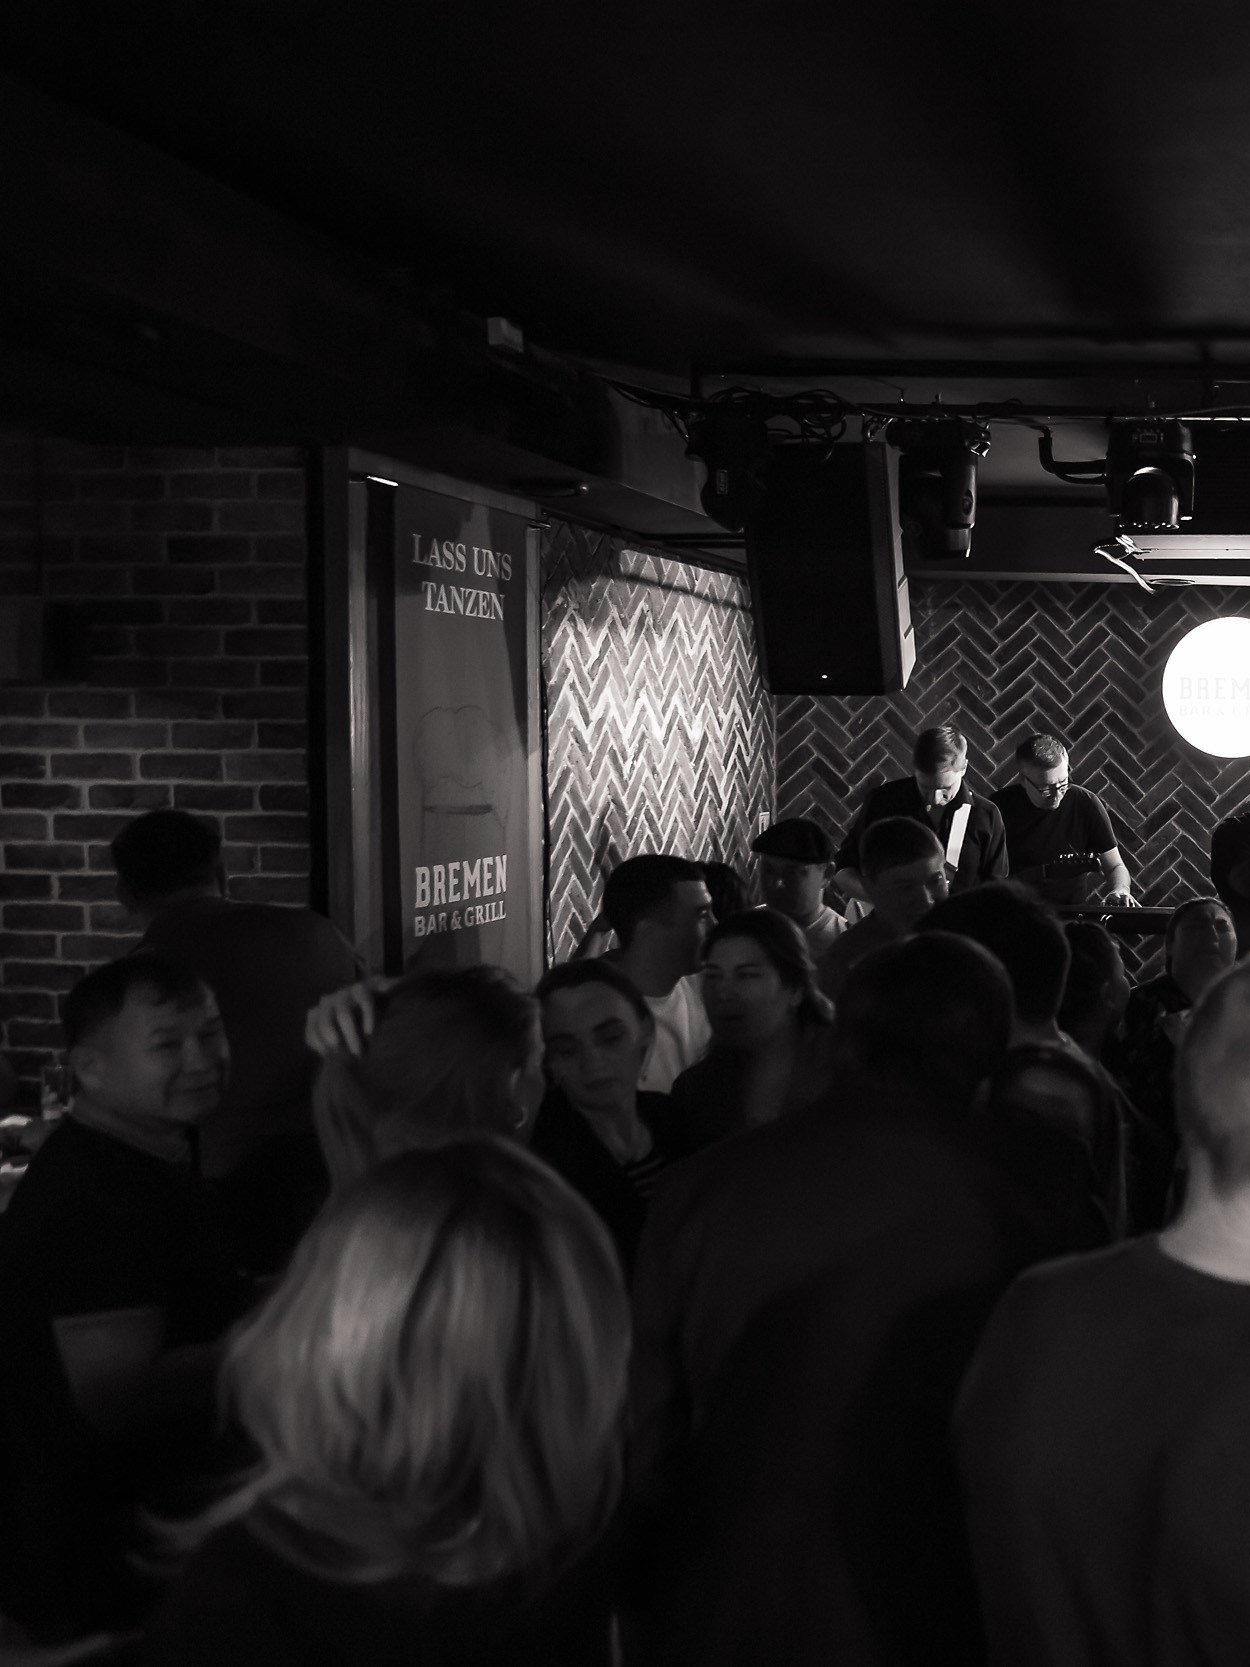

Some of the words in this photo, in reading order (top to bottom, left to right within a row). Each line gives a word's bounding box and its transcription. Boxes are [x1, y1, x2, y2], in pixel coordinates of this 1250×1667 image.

[412, 534, 467, 572] LASS
[472, 546, 512, 581] UNS
[422, 581, 505, 621] TANZEN
[415, 855, 507, 908] BREMEN
[414, 912, 448, 936] BAR
[451, 910, 463, 930] &
[464, 900, 507, 927] GRILL
